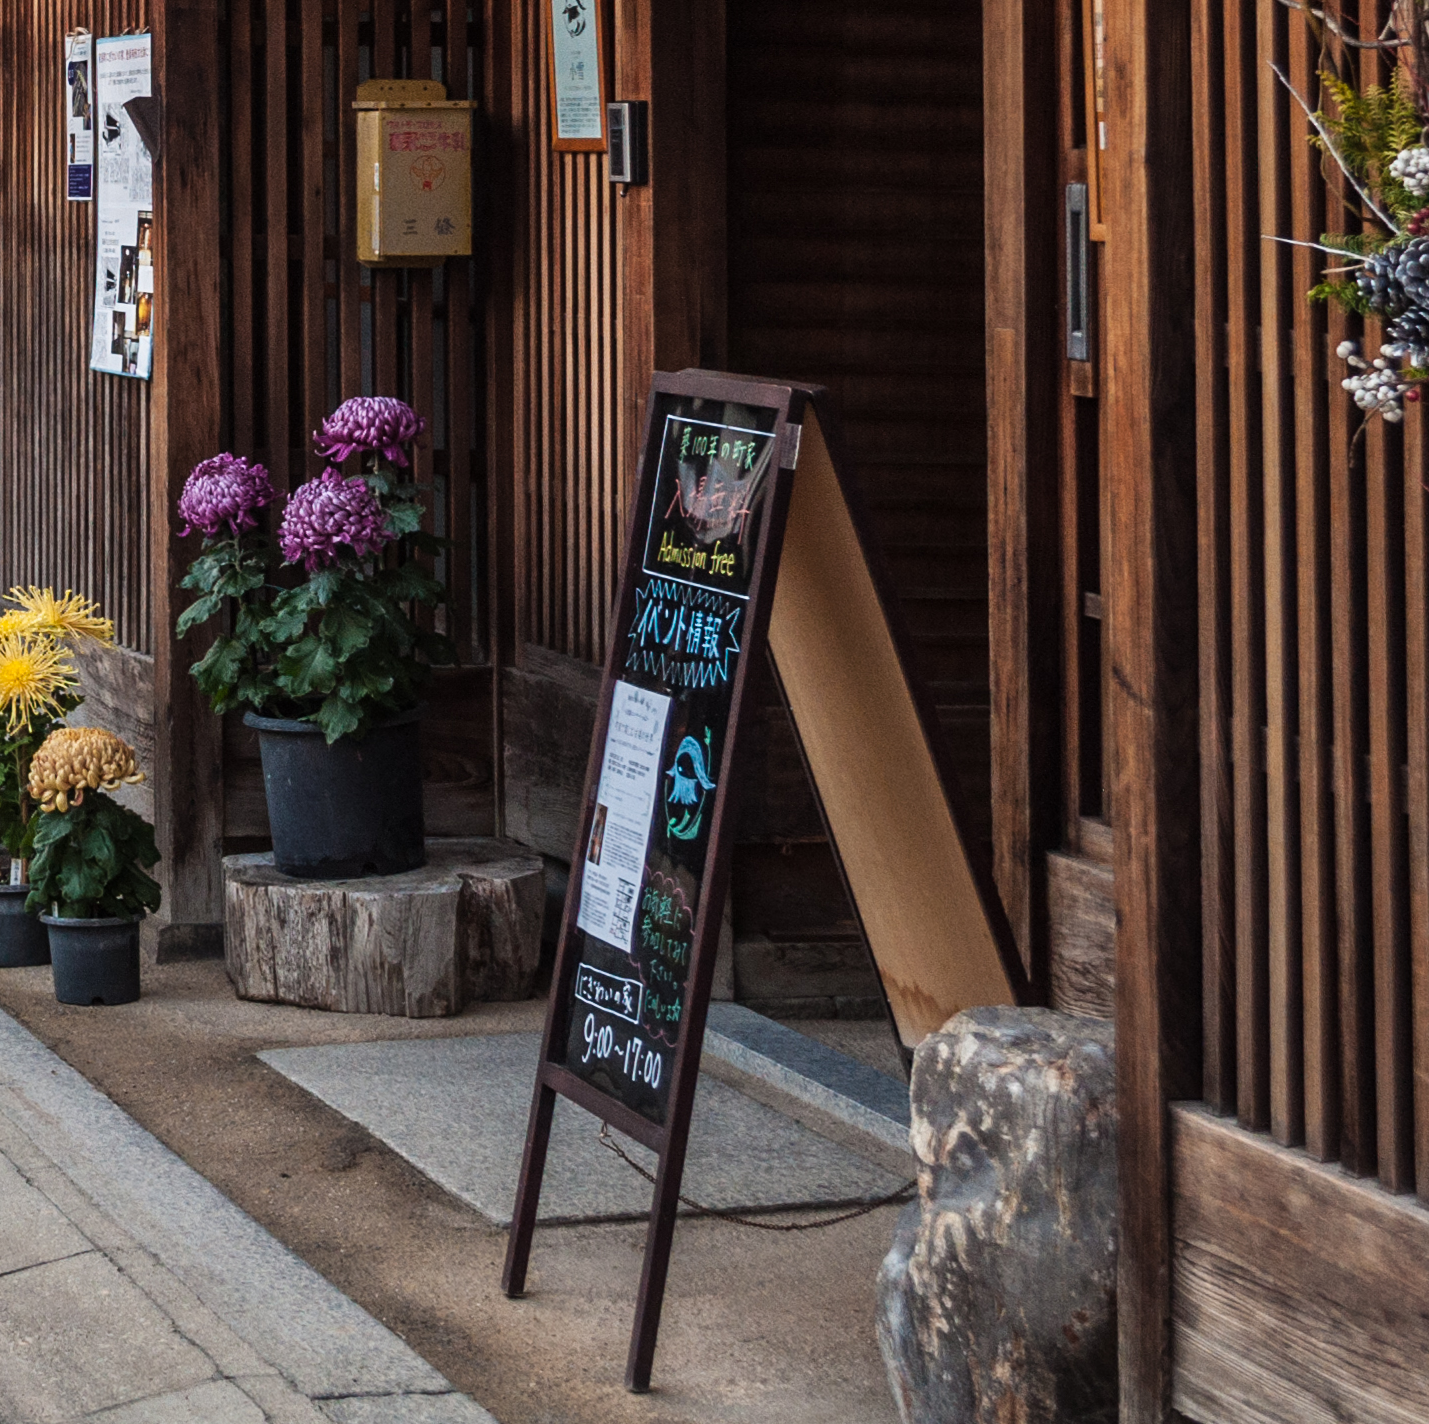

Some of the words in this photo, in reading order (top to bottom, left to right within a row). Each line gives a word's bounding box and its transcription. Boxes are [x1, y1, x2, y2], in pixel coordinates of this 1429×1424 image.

[680, 427, 757, 470] 築100年の町家
[657, 531, 707, 570] Admission
[709, 539, 735, 576] free
[637, 598, 724, 659] イベント情報
[579, 975, 633, 1015] にぎわいの家
